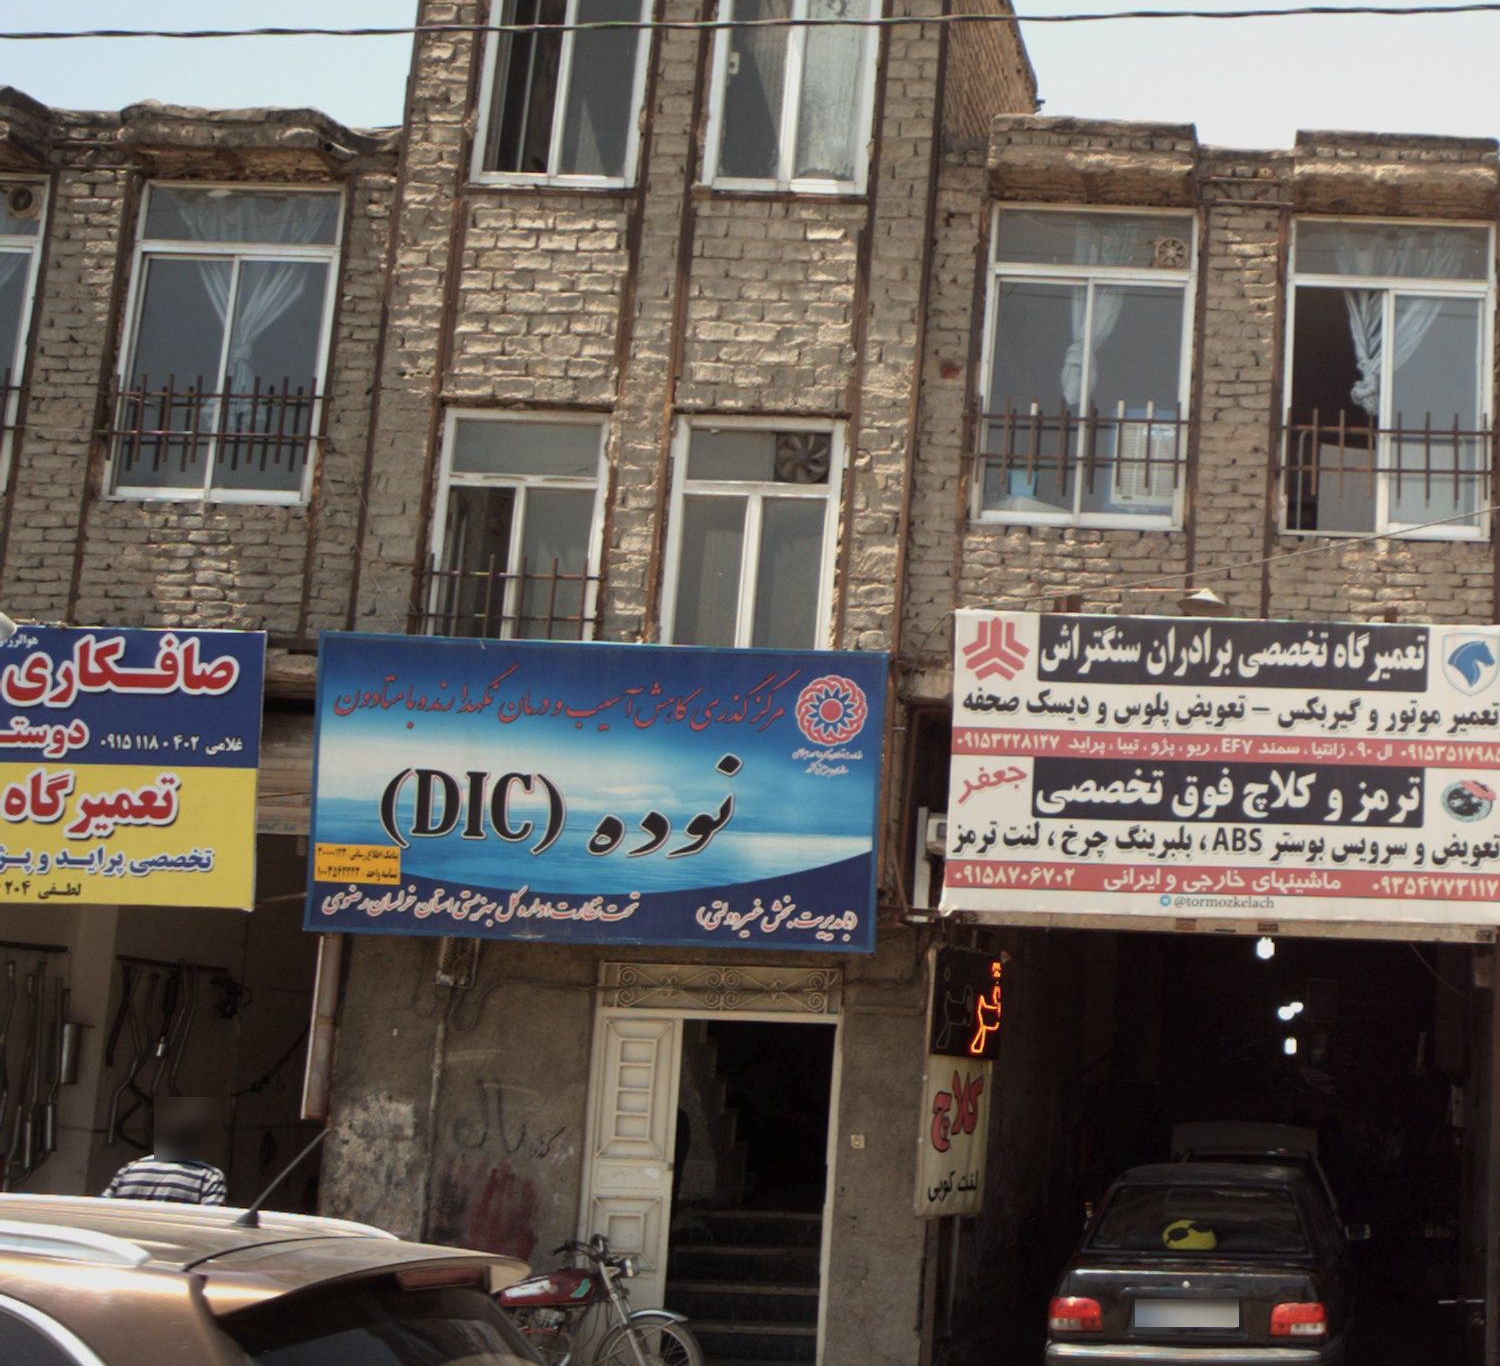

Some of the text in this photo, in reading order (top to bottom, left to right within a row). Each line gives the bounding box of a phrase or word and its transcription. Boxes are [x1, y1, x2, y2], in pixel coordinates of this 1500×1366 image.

[1041, 623, 1426, 682] تعمیرگاه تخصصی برادران سنگتراش
[4, 634, 239, 706] صافکاری
[334, 675, 403, 716] متادون
[498, 689, 549, 723] درمان
[551, 699, 564, 716] و
[565, 687, 645, 731] آسیب
[633, 682, 703, 729] کاهش
[690, 673, 777, 732] گذری
[750, 668, 801, 732] مرکز
[1026, 689, 1089, 722] دیسک
[1114, 692, 1169, 726] پلوس
[1175, 695, 1246, 727] تعویض
[1095, 701, 1107, 724] و
[1278, 696, 1361, 730] گیربکس
[1366, 708, 1378, 731] و
[1384, 700, 1441, 733] موتور
[1447, 702, 1500, 734] تعمیر
[0, 716, 89, 758] دوست
[205, 738, 243, 755] غلامی
[1257, 742, 1300, 756] سمند
[958, 765, 1028, 805] جعفر
[1036, 768, 1421, 823] ترمز و کلاچ فوق تخصصی
[1, 768, 180, 839] تعمیرگاه
[587, 752, 743, 858] نوده
[952, 821, 997, 853] ترمز
[1003, 821, 1040, 847] لنت
[1061, 824, 1108, 857] چرخ
[1115, 824, 1192, 858] بلبرینگ
[1212, 827, 1262, 852] ABS
[1270, 832, 1325, 862] بوستر
[37, 850, 50, 873] و
[55, 846, 124, 878] پراید
[128, 847, 214, 877] تخصصی
[1331, 837, 1408, 864] سرویس
[1413, 843, 1425, 865] و
[38, 882, 82, 900] لطفی
[1103, 869, 1161, 891] ایرانی
[1165, 871, 1176, 891] و
[1182, 870, 1246, 892] خارجی
[1252, 872, 1341, 893] ماشینهای
[322, 884, 368, 916] رضوی
[600, 891, 641, 922] تحت
[931, 1069, 984, 1153] کلاچ
[928, 1170, 978, 1202] لنت کوبی
